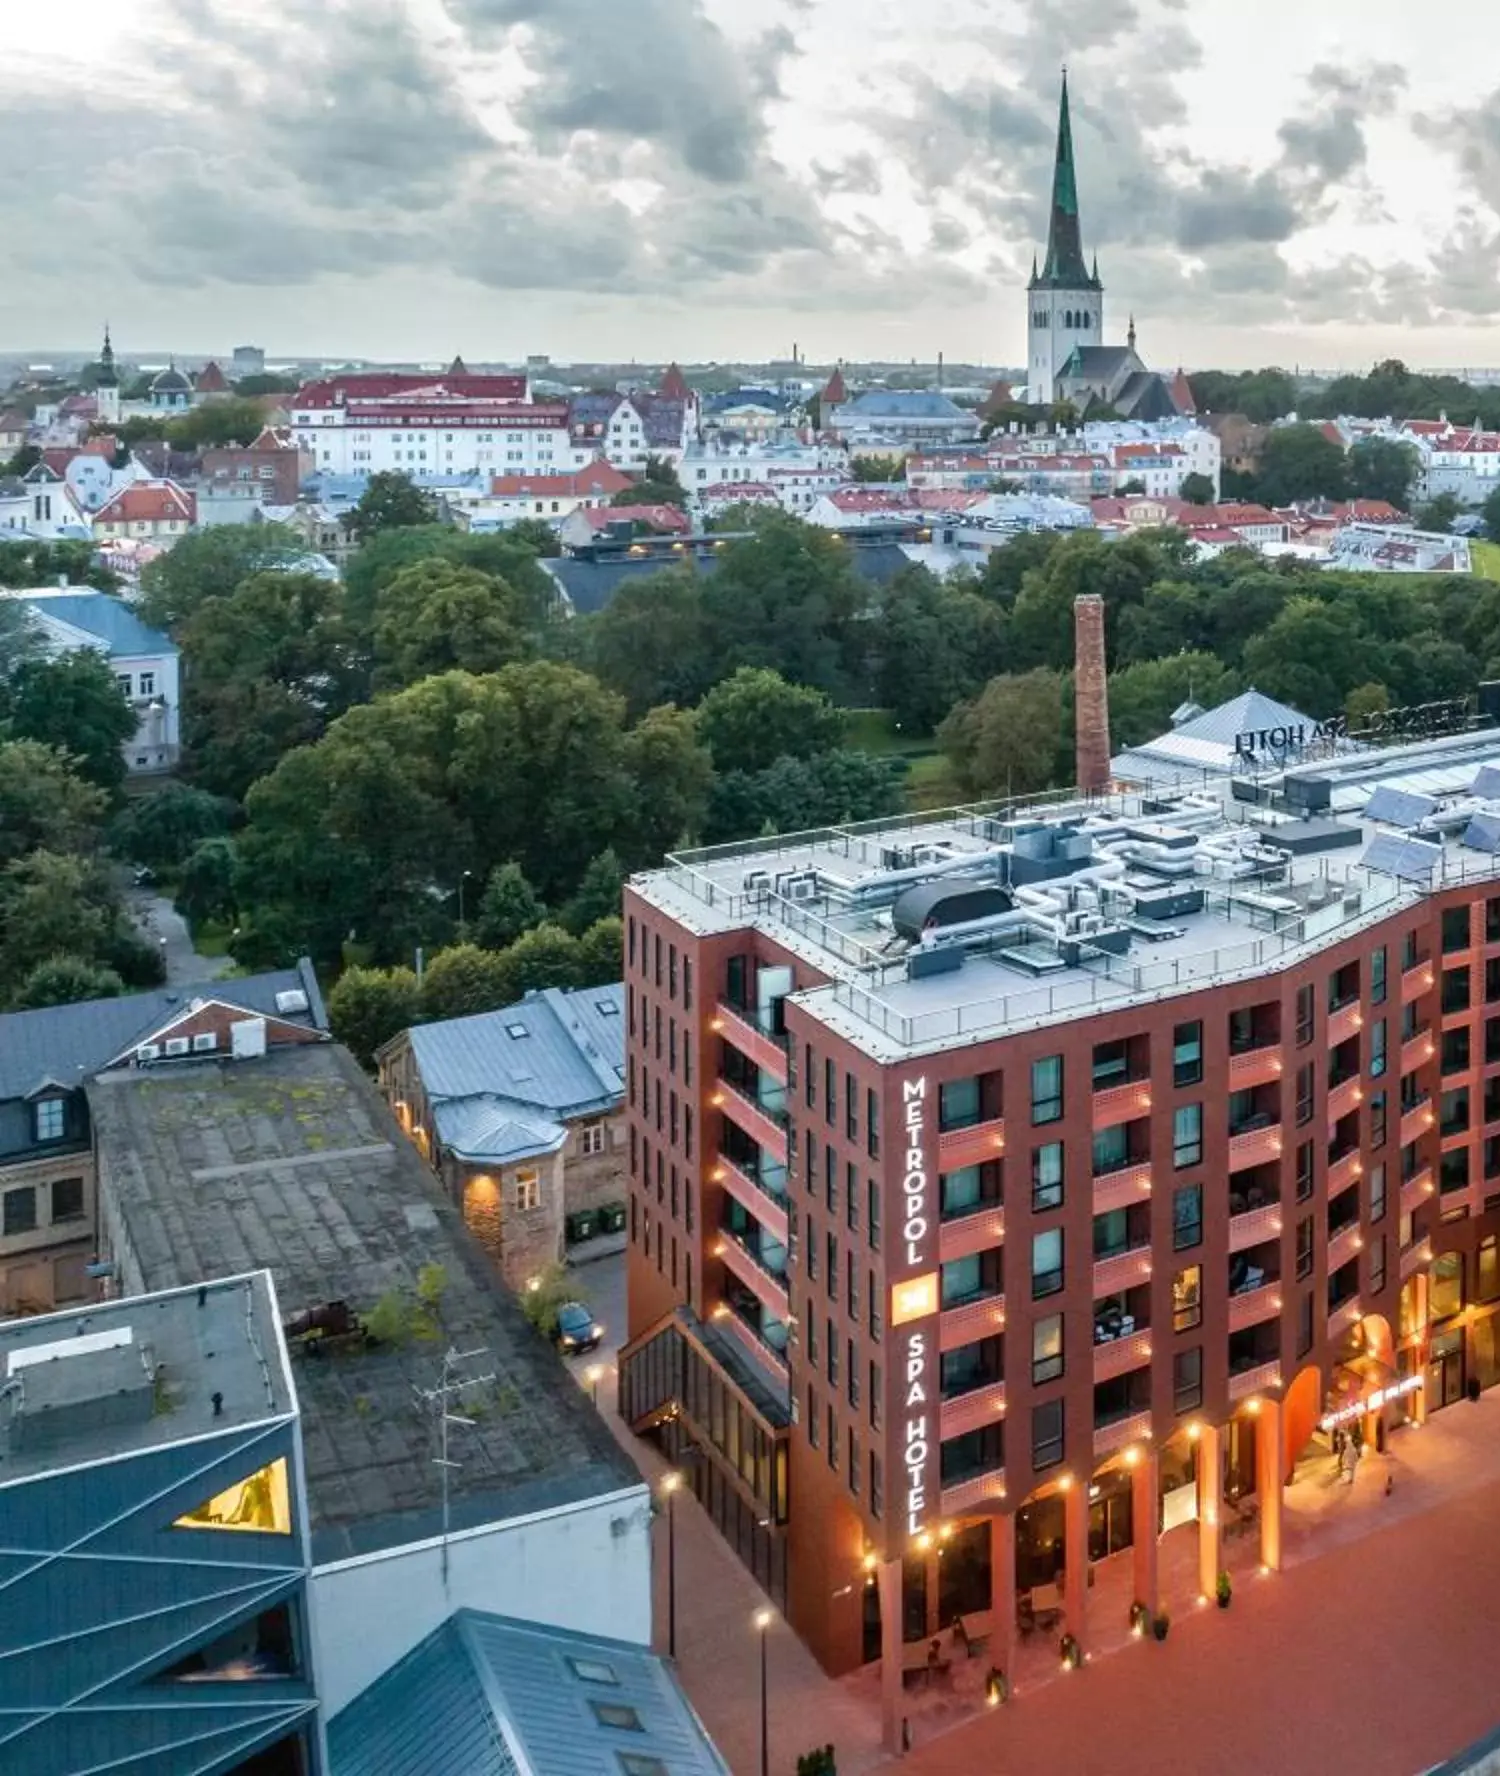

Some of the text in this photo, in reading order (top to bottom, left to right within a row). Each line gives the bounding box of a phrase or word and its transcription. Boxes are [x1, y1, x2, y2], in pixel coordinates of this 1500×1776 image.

[903, 1075, 927, 1265] METROPOL
[904, 1333, 927, 1536] SPA HOTEL
